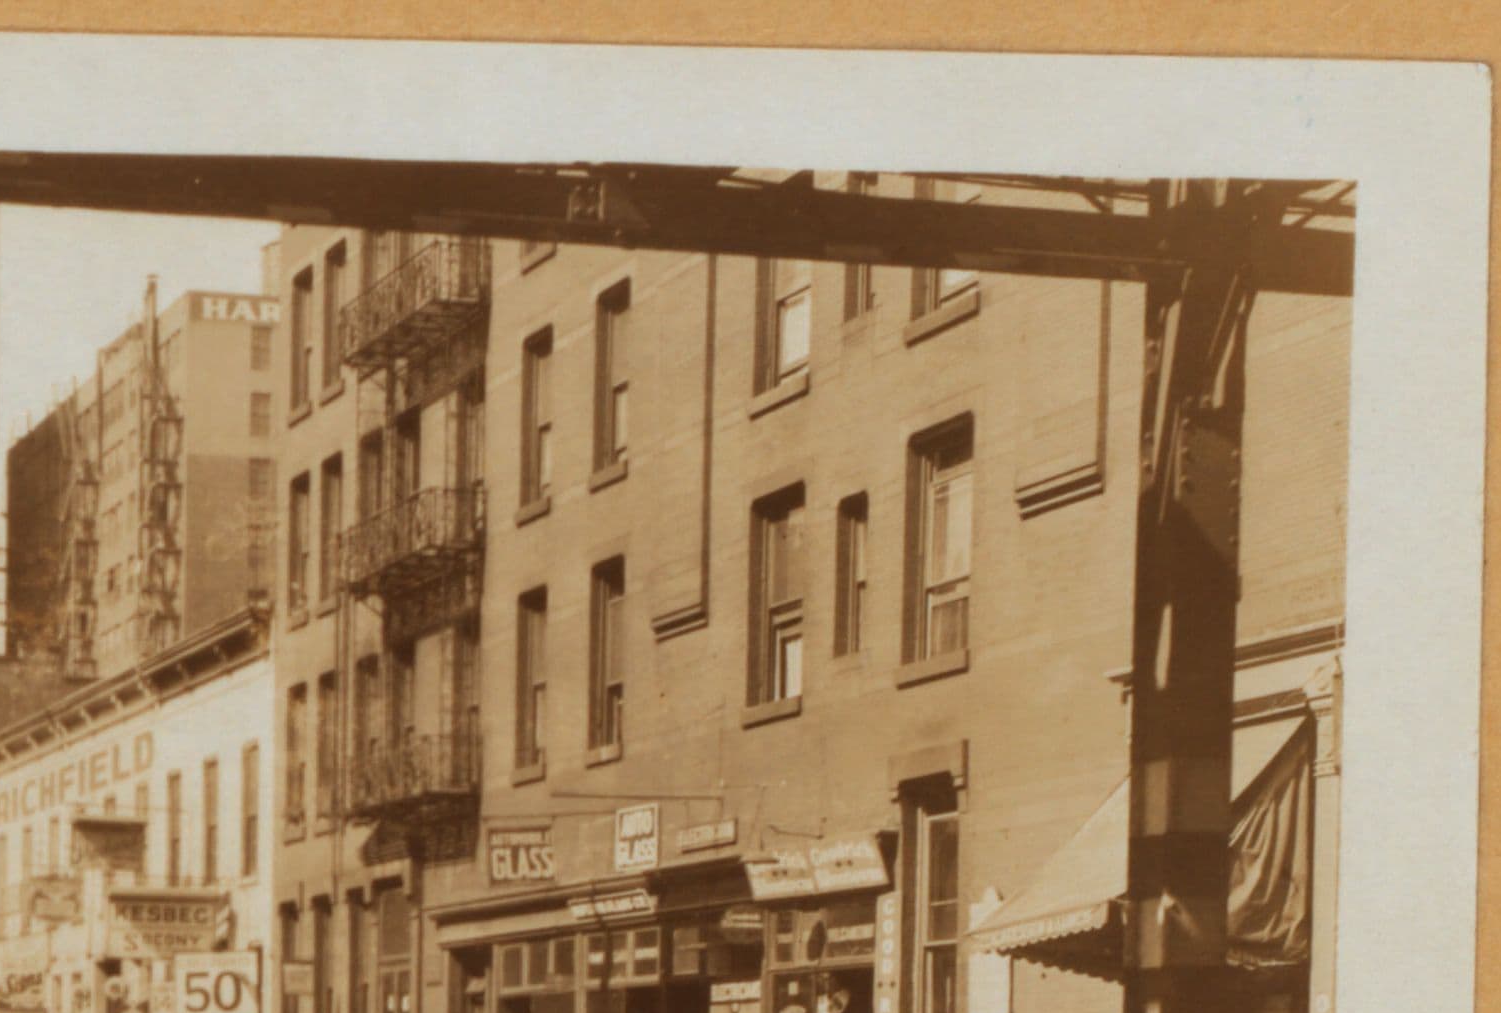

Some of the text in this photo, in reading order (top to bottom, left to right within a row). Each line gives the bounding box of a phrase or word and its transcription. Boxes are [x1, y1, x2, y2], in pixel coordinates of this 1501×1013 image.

[622, 810, 653, 837] AUTO
[492, 846, 557, 880] GLASS
[617, 839, 658, 866] GLASS
[116, 904, 209, 924] KESBEC
[185, 971, 243, 1013] 50
